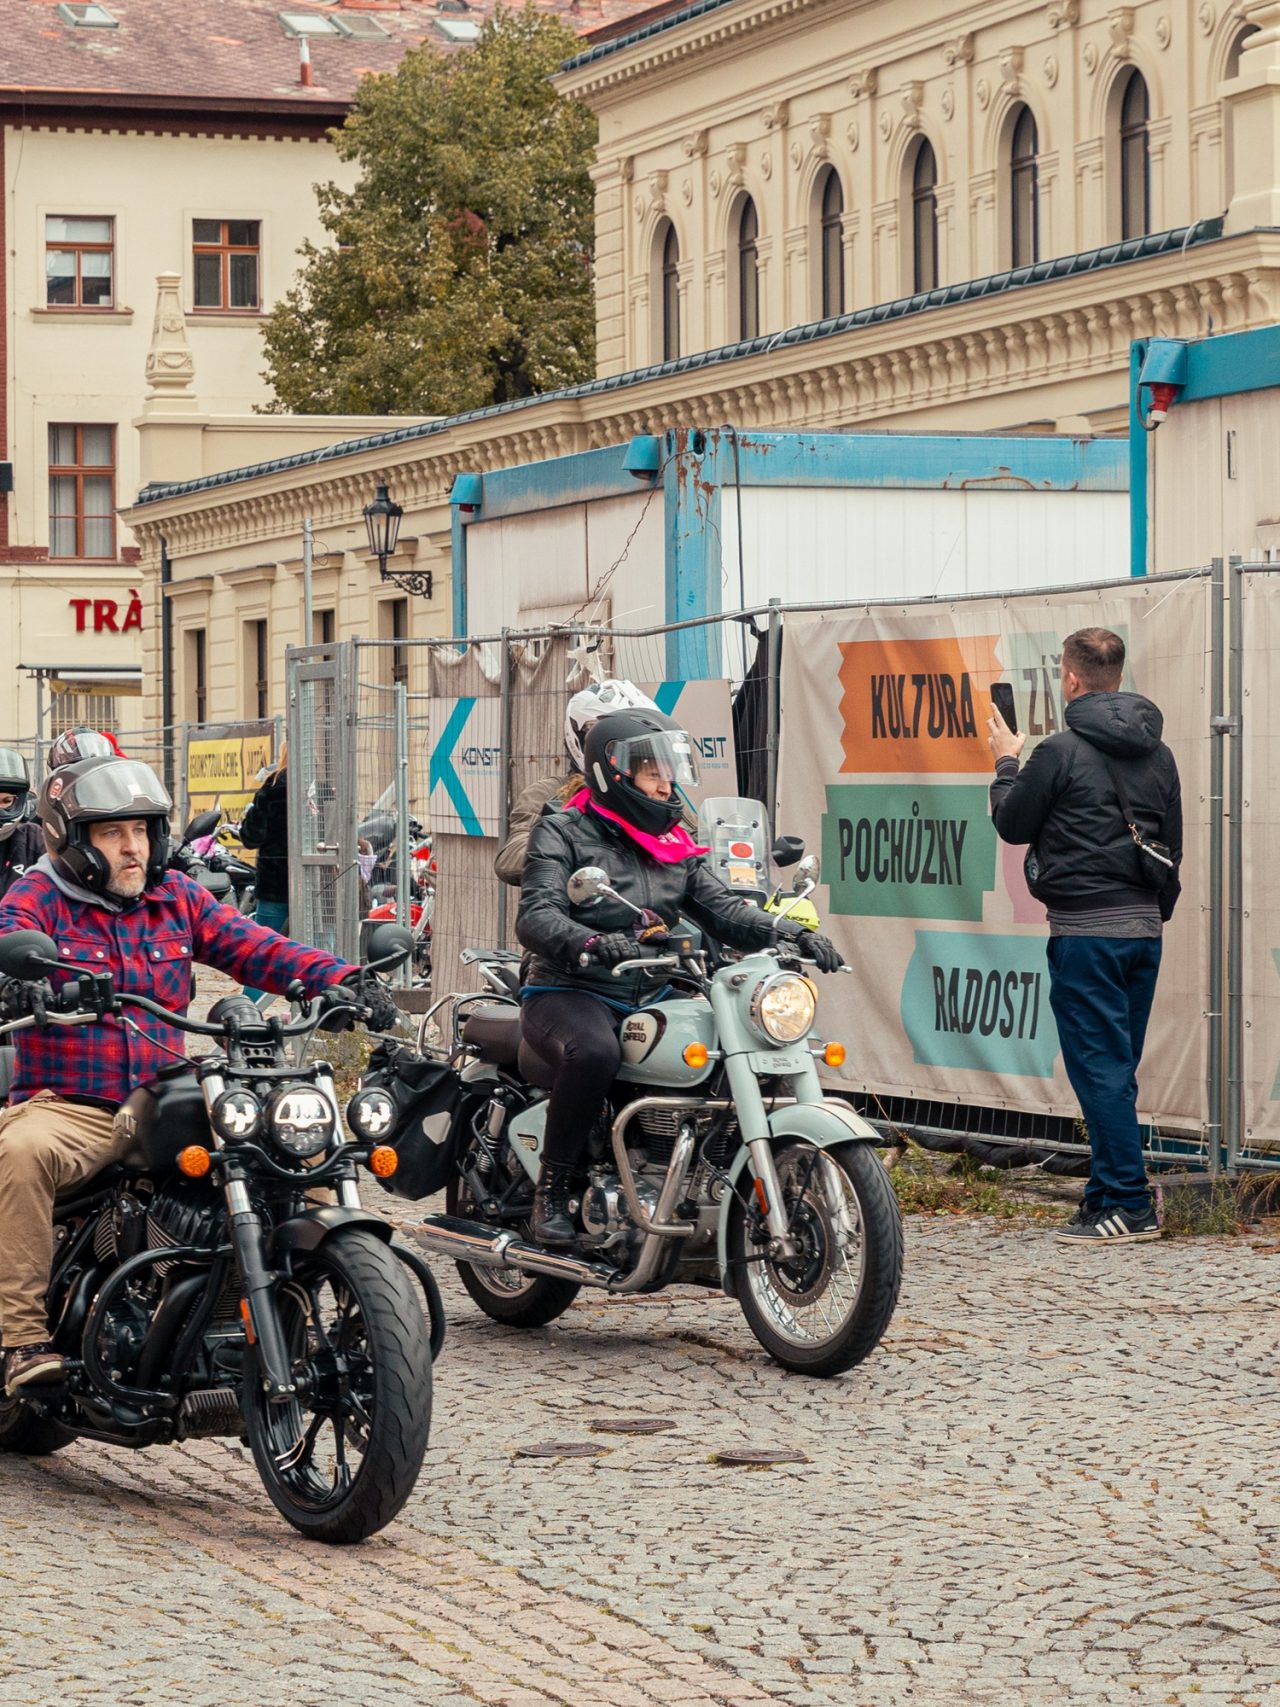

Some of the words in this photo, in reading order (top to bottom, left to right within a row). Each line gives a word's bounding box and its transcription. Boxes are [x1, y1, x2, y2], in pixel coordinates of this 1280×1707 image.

[871, 672, 978, 739] KULTURA
[838, 801, 968, 886] POCHŮZKY
[932, 965, 1041, 1040] RADOSTI
